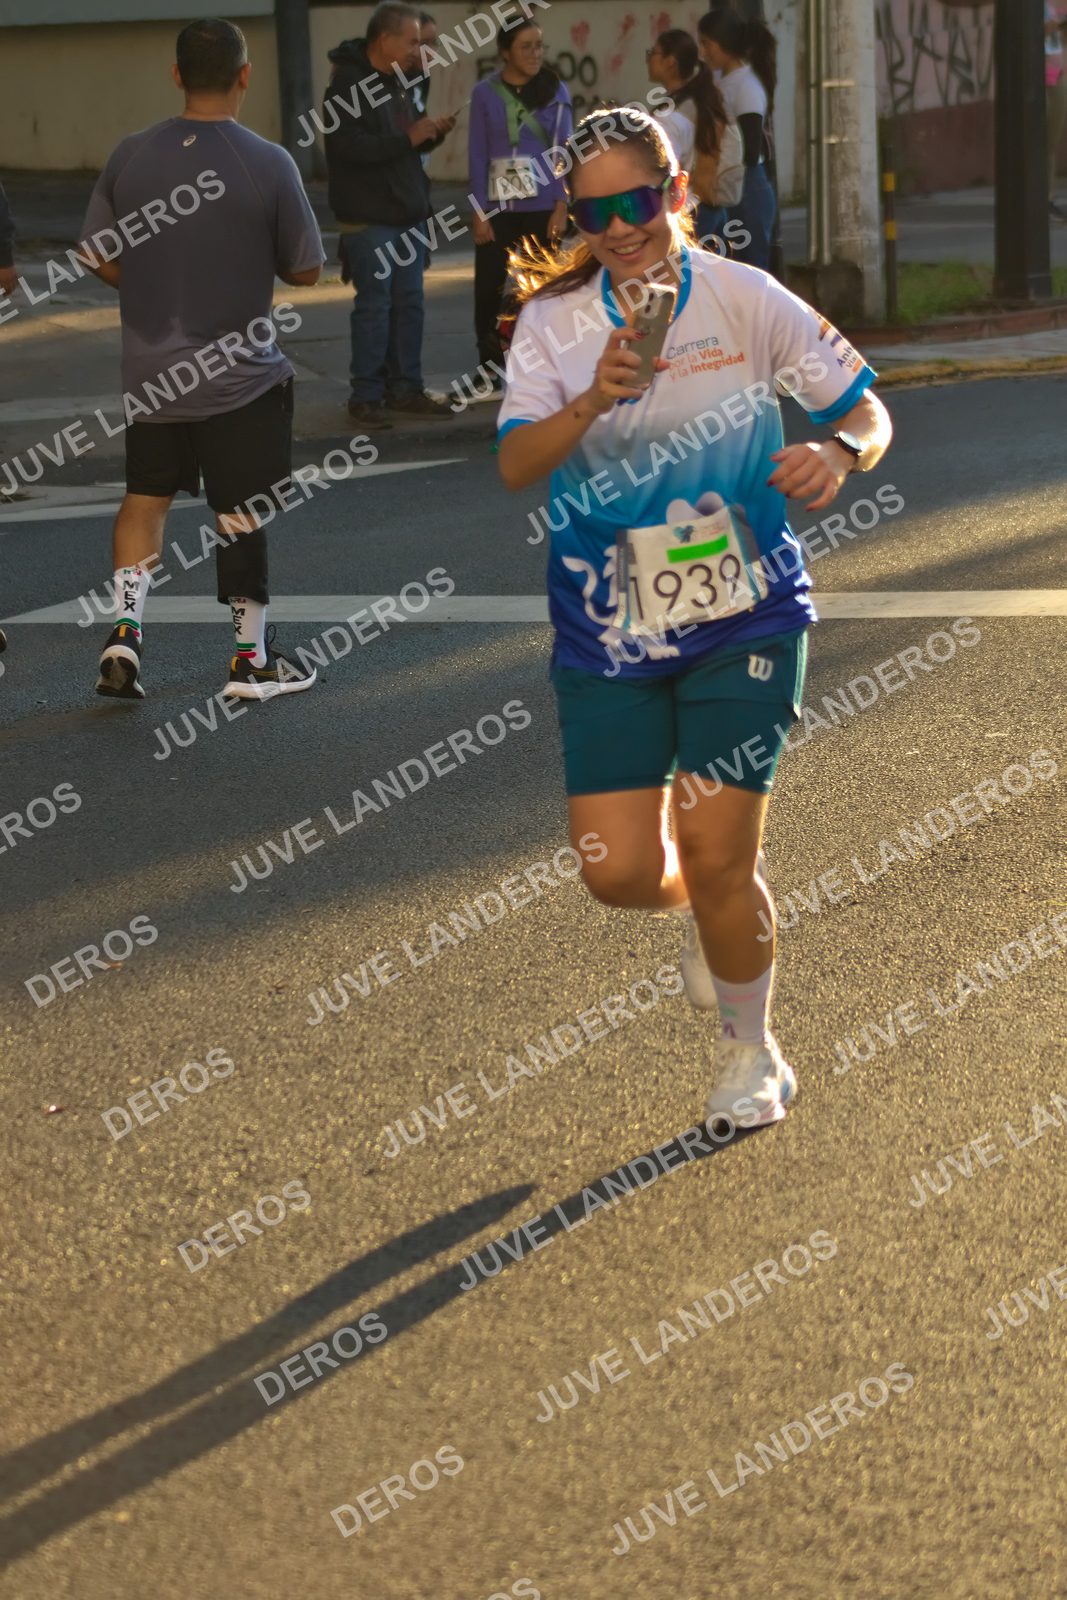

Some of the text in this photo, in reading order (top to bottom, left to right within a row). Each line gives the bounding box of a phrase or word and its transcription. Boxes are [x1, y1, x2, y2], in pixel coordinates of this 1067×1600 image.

[666, 337, 719, 359] Carrera
[687, 353, 698, 364] la
[699, 347, 724, 360] Vida
[678, 367, 689, 378] la
[690, 351, 745, 373] Integridad
[123, 580, 140, 612] MEX
[629, 553, 741, 621] 1939
[231, 606, 246, 635] MEX
